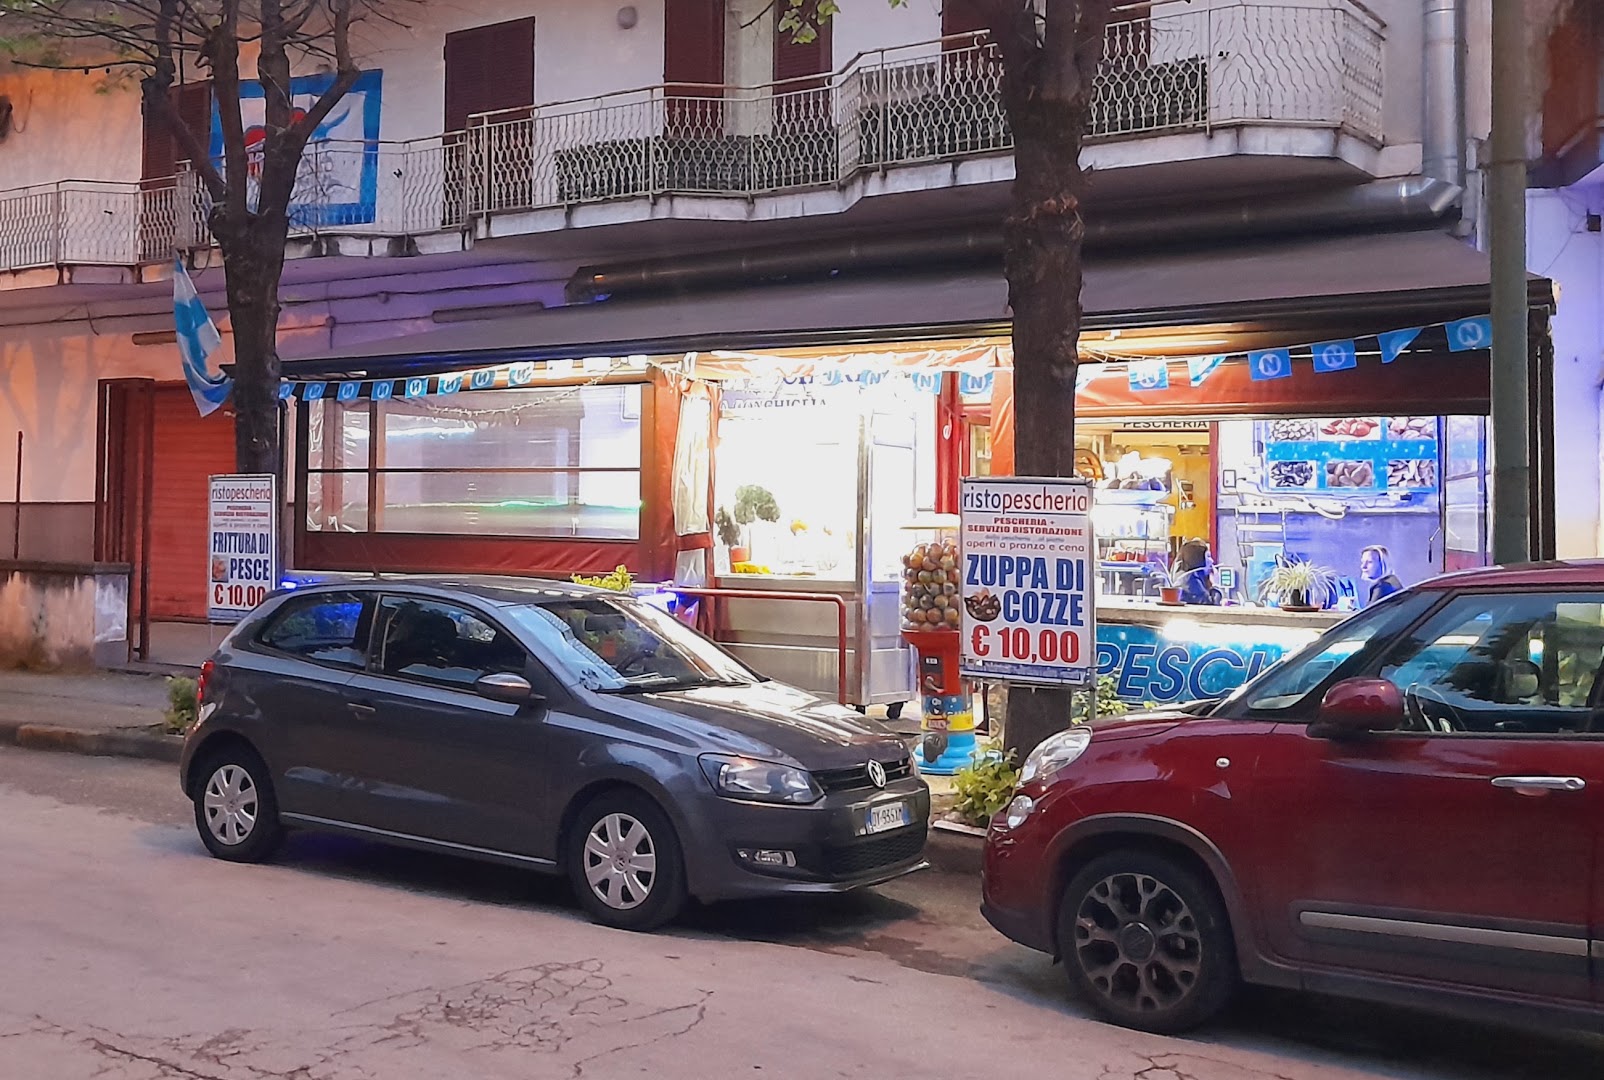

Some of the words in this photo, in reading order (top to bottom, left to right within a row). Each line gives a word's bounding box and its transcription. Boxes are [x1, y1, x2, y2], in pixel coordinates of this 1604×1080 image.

[211, 483, 271, 501] ristopescheria
[963, 486, 1087, 514] ristopescheria
[967, 524, 1010, 534] SERVIZIO
[1012, 526, 1084, 537] RISTORAZIONE
[993, 517, 1047, 526] PESCHERIA
[213, 531, 257, 554] FRITTURA
[259, 532, 269, 555] DI
[966, 540, 996, 550] aperti
[1009, 542, 1046, 551] pranzo
[1058, 544, 1085, 552] cena
[230, 558, 269, 581] PESCE
[966, 554, 1049, 590] ZUPPA
[1056, 558, 1084, 592] DI
[1003, 589, 1084, 627] COZZE
[970, 624, 990, 657] €
[997, 626, 1080, 664] 10,00
